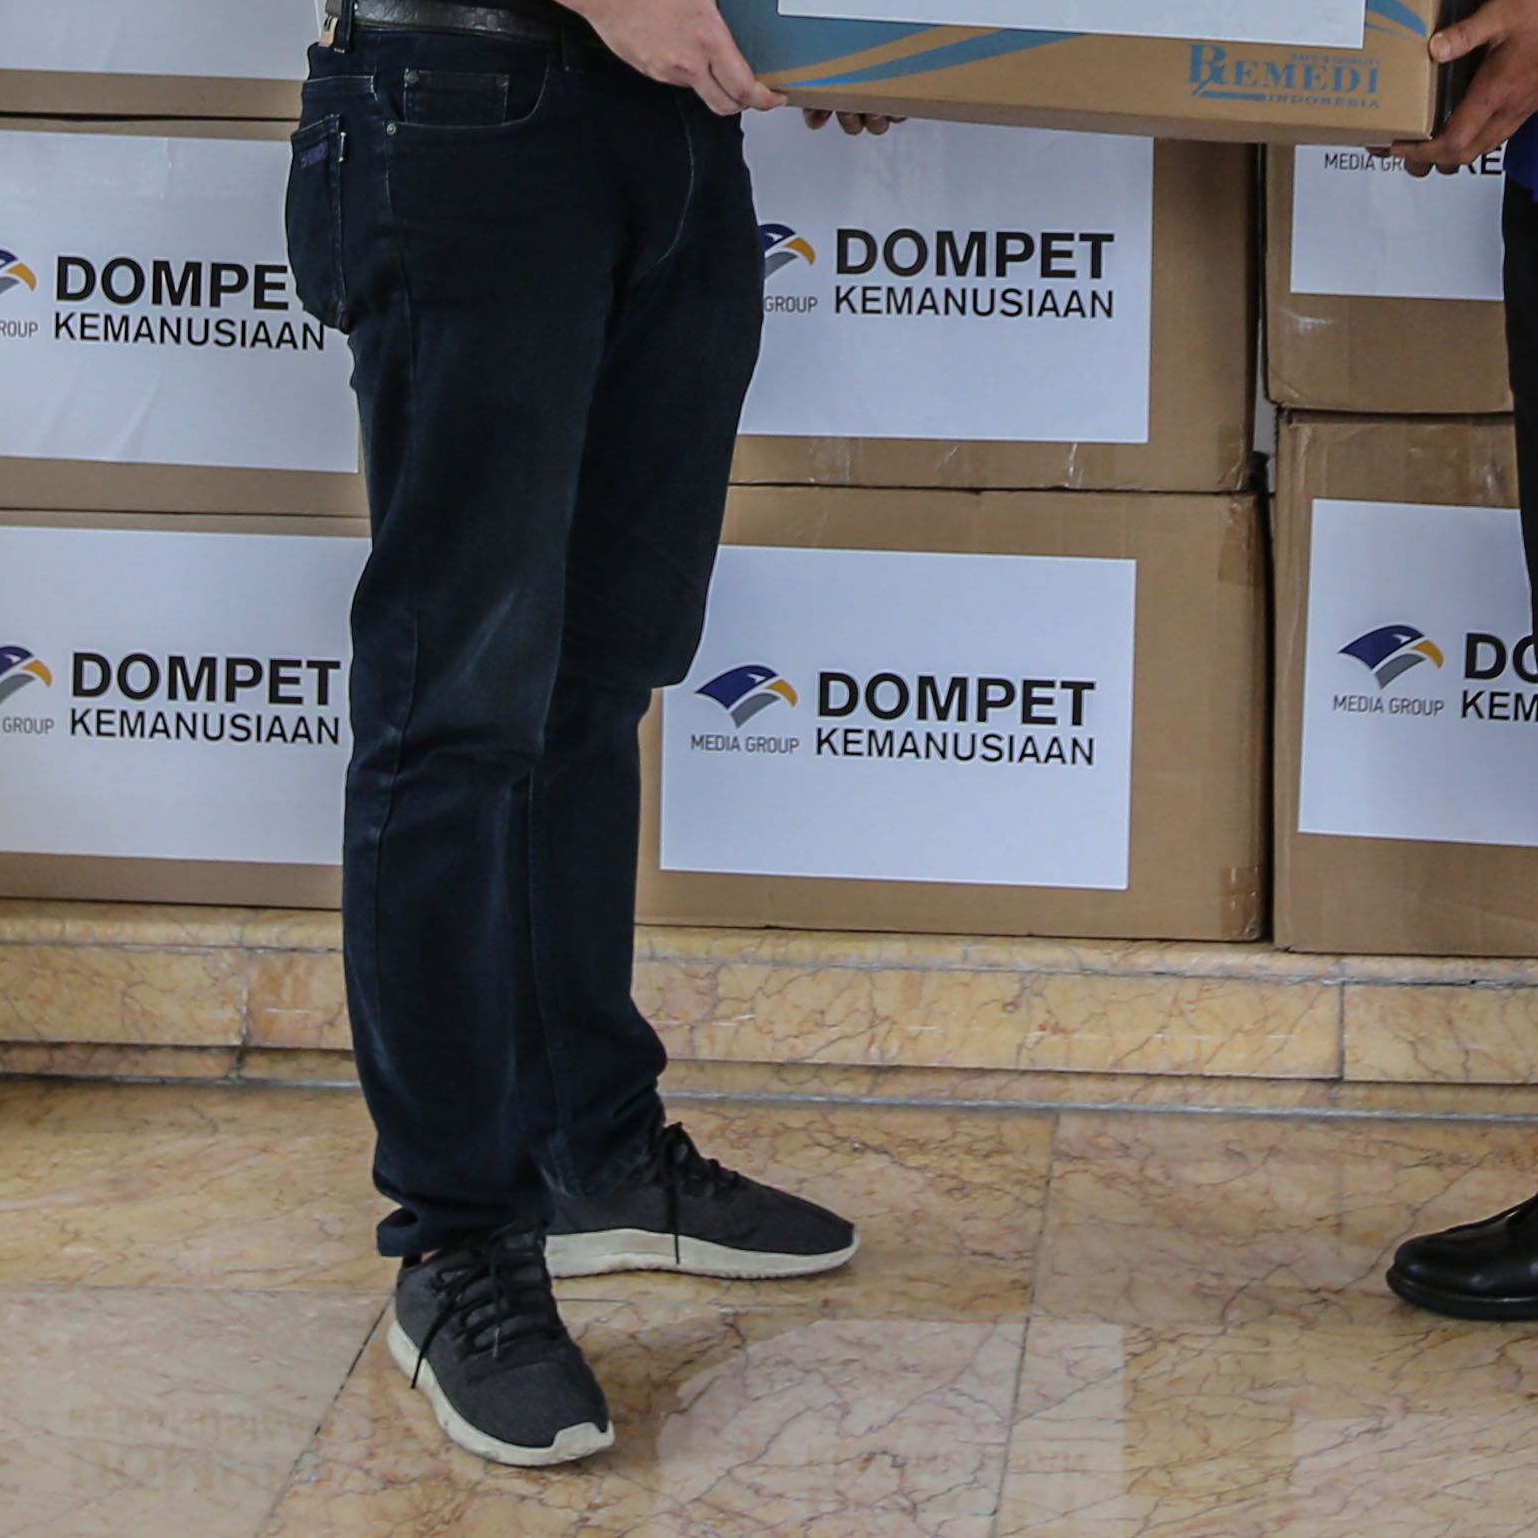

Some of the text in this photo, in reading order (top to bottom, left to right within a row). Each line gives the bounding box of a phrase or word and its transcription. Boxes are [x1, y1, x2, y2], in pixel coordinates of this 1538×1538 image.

[1186, 42, 1382, 96] REMEDI
[1324, 152, 1376, 170] MEDIA
[837, 229, 1114, 279] DOMPET
[57, 256, 288, 310] DOMPE
[764, 296, 818, 313] GROUP
[835, 286, 1112, 318] KEMANUSIAAN
[54, 312, 324, 350] KEMANUSIAAN
[73, 652, 341, 705] DOMPET
[818, 672, 1095, 726] DOMPET
[1333, 695, 1384, 713] MEDIA
[1389, 697, 1444, 716] GROUP
[2, 716, 54, 734] GROUP
[71, 708, 338, 744] KEMANUSIAAN
[691, 734, 799, 753] MEDIA GROUP
[817, 728, 1093, 765] KEMANUSIAAN
